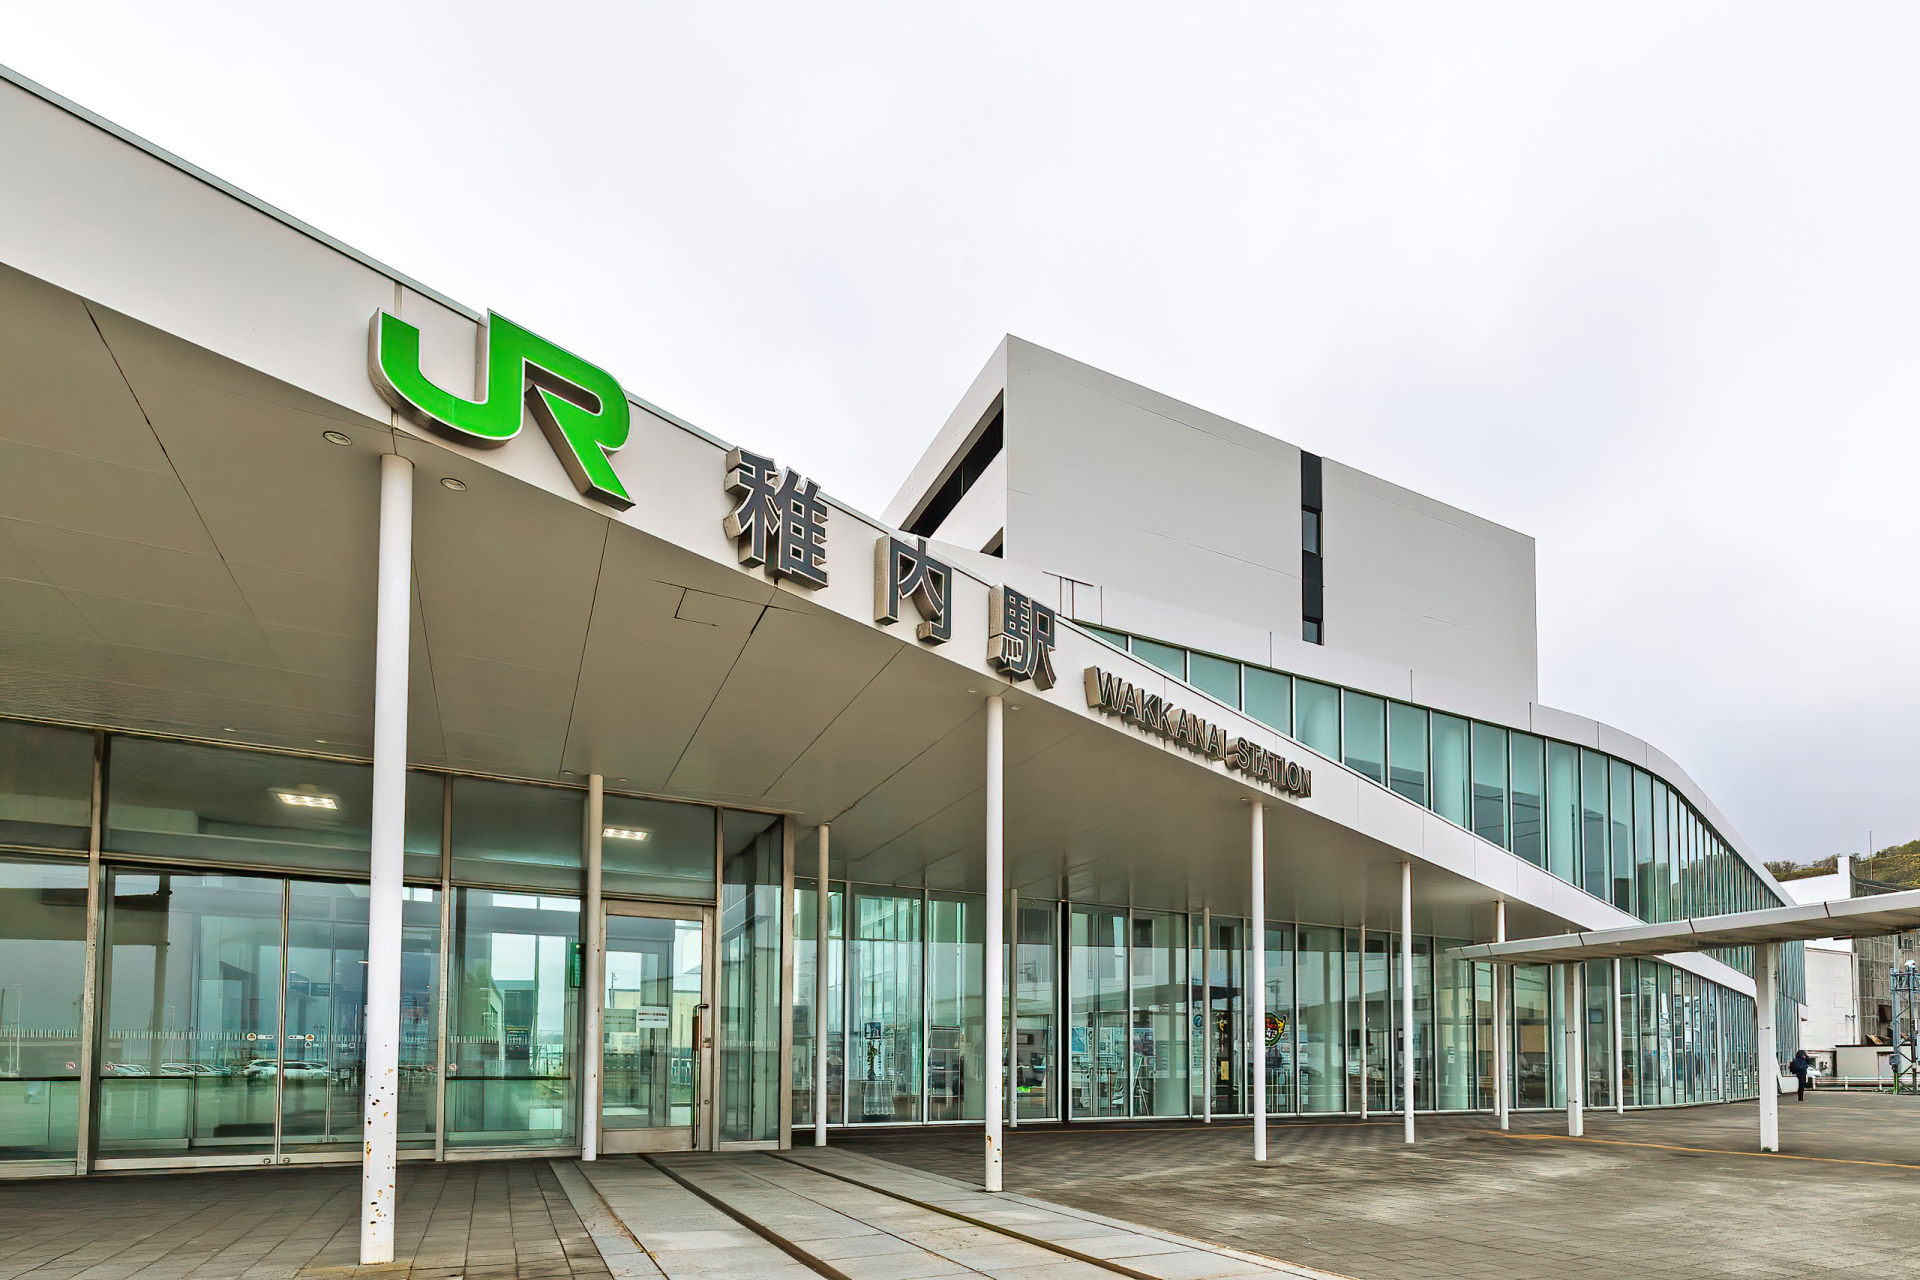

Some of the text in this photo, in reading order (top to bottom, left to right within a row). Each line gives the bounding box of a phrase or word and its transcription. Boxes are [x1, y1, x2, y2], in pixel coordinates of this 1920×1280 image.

[372, 308, 635, 510] JR
[726, 447, 1057, 690] 稚内駅
[1090, 666, 1312, 797] WAKKANAI STATION
